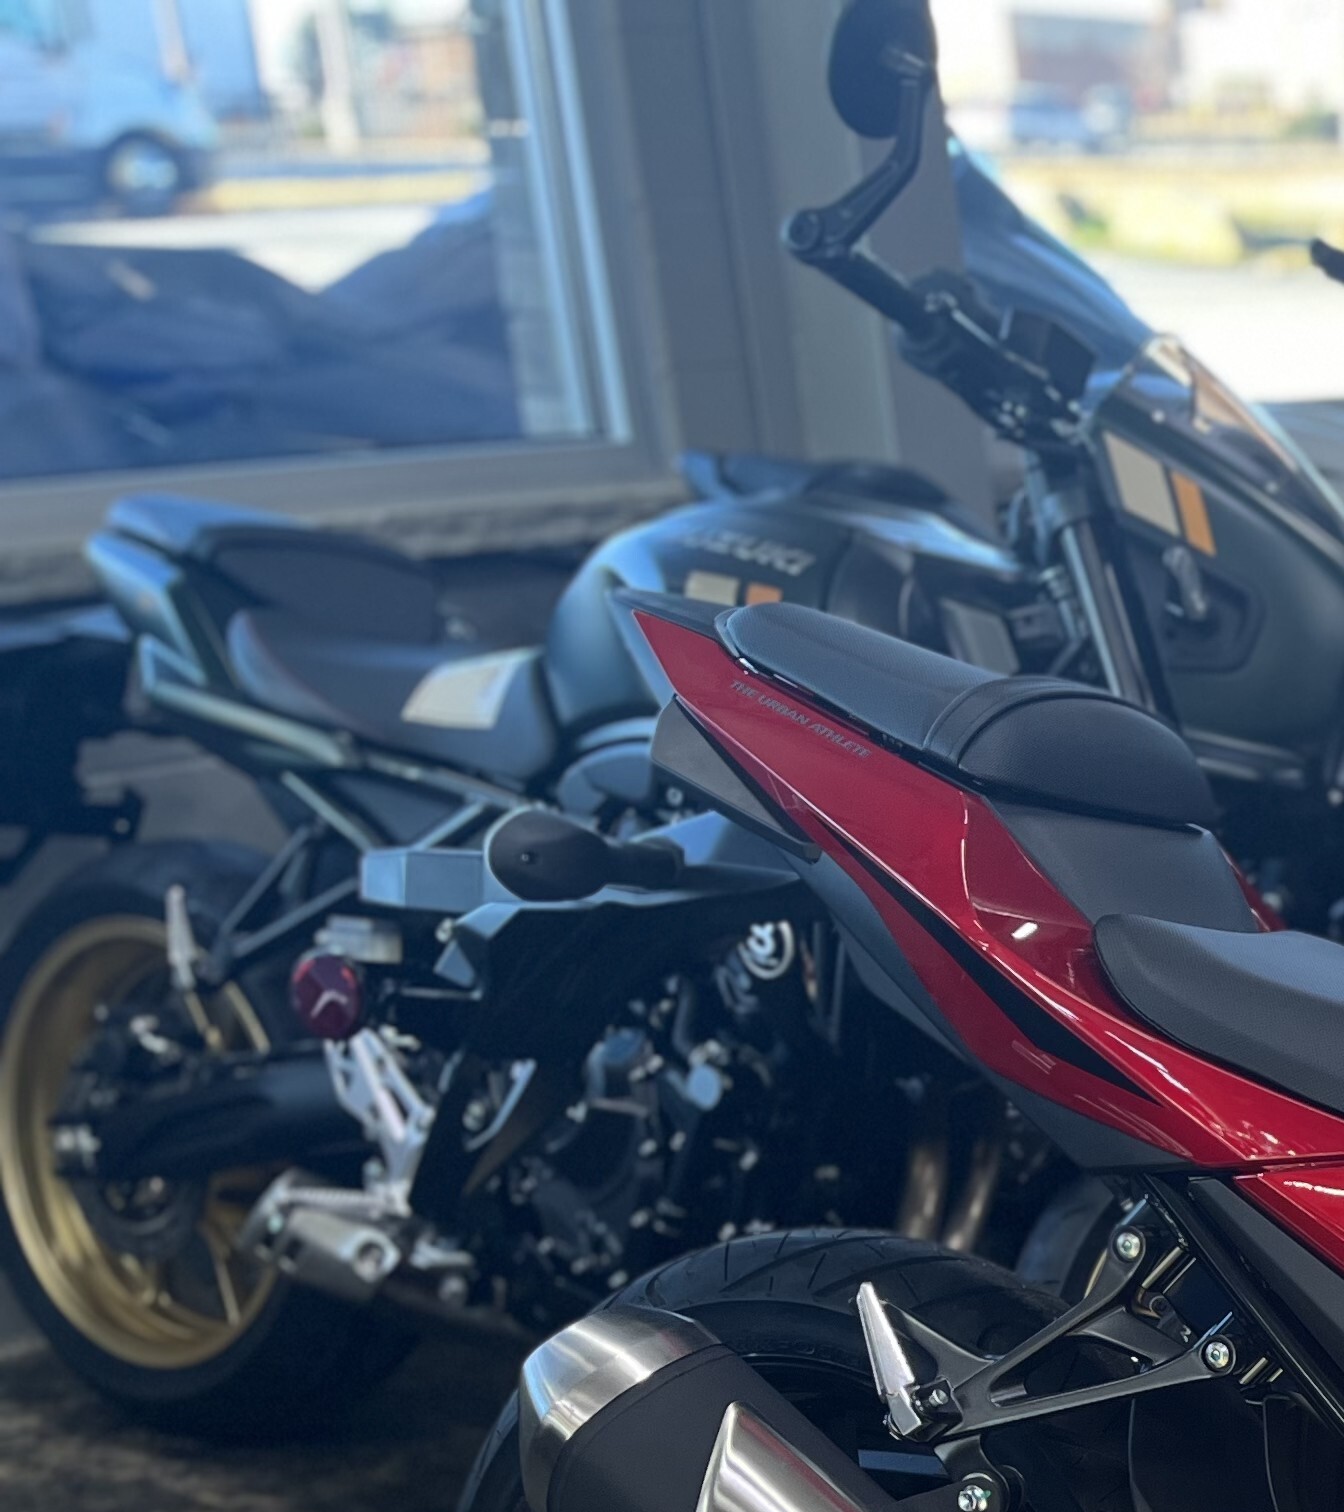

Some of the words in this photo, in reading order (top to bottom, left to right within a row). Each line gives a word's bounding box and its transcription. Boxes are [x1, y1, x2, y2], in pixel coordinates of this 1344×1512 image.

[730, 680, 758, 698] THE
[758, 694, 811, 726] URBAN
[809, 723, 872, 758] ATHLETE
